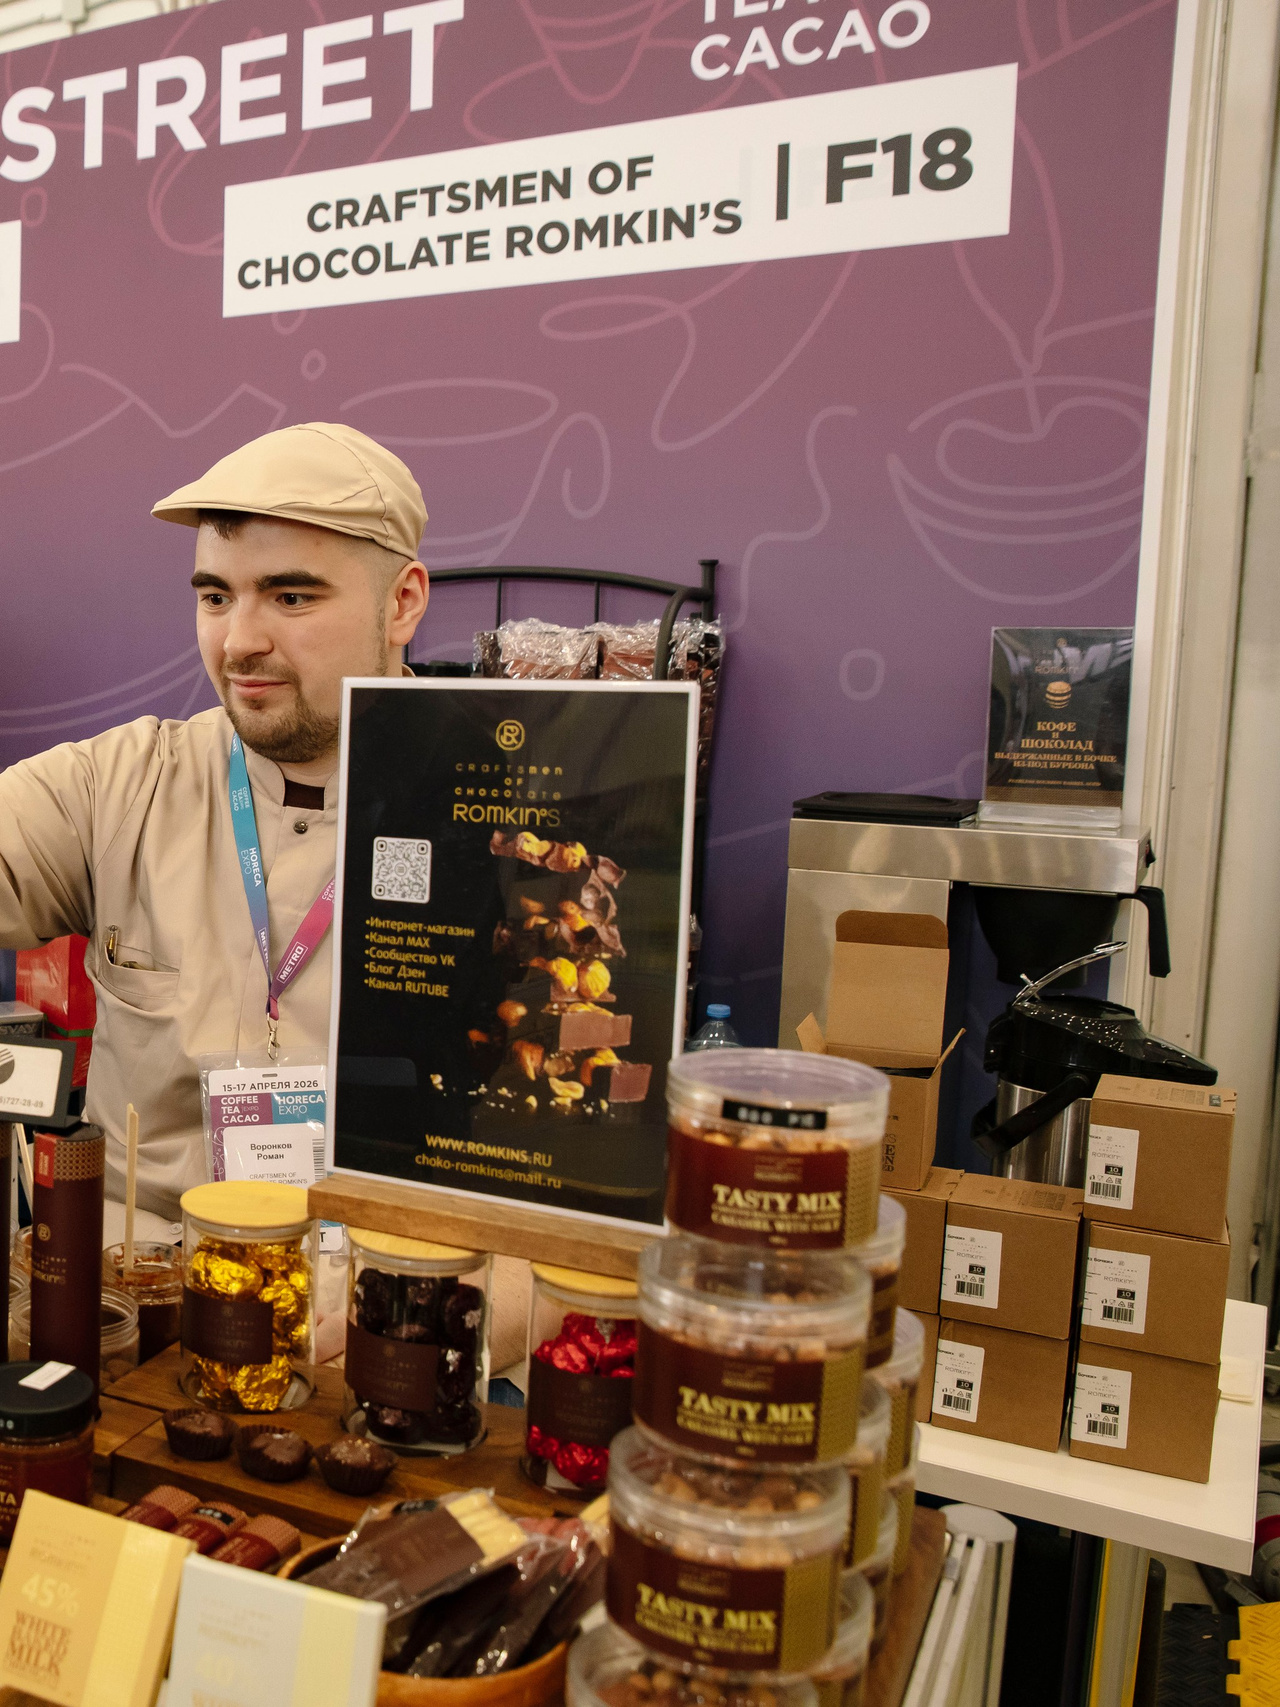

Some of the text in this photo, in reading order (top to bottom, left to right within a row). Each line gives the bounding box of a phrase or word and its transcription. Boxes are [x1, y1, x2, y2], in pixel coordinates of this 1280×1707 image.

[690, 0, 932, 81] CACAO
[824, 126, 975, 206] F18
[305, 154, 656, 234] CRAFTSMEN OF
[236, 197, 743, 291] CHOCOLATE ROMKIN’S
[1036, 721, 1077, 732] КОФЕ
[1020, 738, 1095, 752] ШОКОЛАД
[994, 752, 1118, 764] ВЫДЕРЖАННЫЕ В БОЧКЕ
[1012, 760, 1095, 771] ИЗ-ПОД БУРБОНА
[231, 790, 239, 812] CACAO
[242, 786, 250, 809] COFFEE
[240, 849, 252, 875] EXPO
[249, 847, 262, 887] HORECA
[369, 932, 404, 946] Канал
[278, 944, 305, 982] METRO
[369, 947, 456, 967] Сообщество VK
[368, 961, 426, 979] Блог Дзен
[368, 977, 449, 998] Канал RUTUBE
[222, 1080, 319, 1092] 15-17 АПРЕЛЯ 2026
[221, 1095, 259, 1105] COFFEE
[277, 1094, 324, 1105] HORECA
[221, 1106, 241, 1114] TEA
[222, 1114, 260, 1124] CACAO
[278, 1105, 308, 1116] EXPO
[249, 1142, 293, 1152] Воронков
[425, 1134, 553, 1168] WWW.ROMKINS.RU
[256, 1153, 285, 1162] Роман
[249, 1172, 285, 1180] CRAFTSMEN
[414, 1152, 562, 1189] choko-romkins@mail.ru
[712, 1183, 842, 1213] TASTY MIX
[678, 1385, 816, 1425] TASTY MIX
[20, 1572, 81, 1619] 45%
[636, 1582, 719, 1628] TASTY
[722, 1610, 777, 1632] MIX
